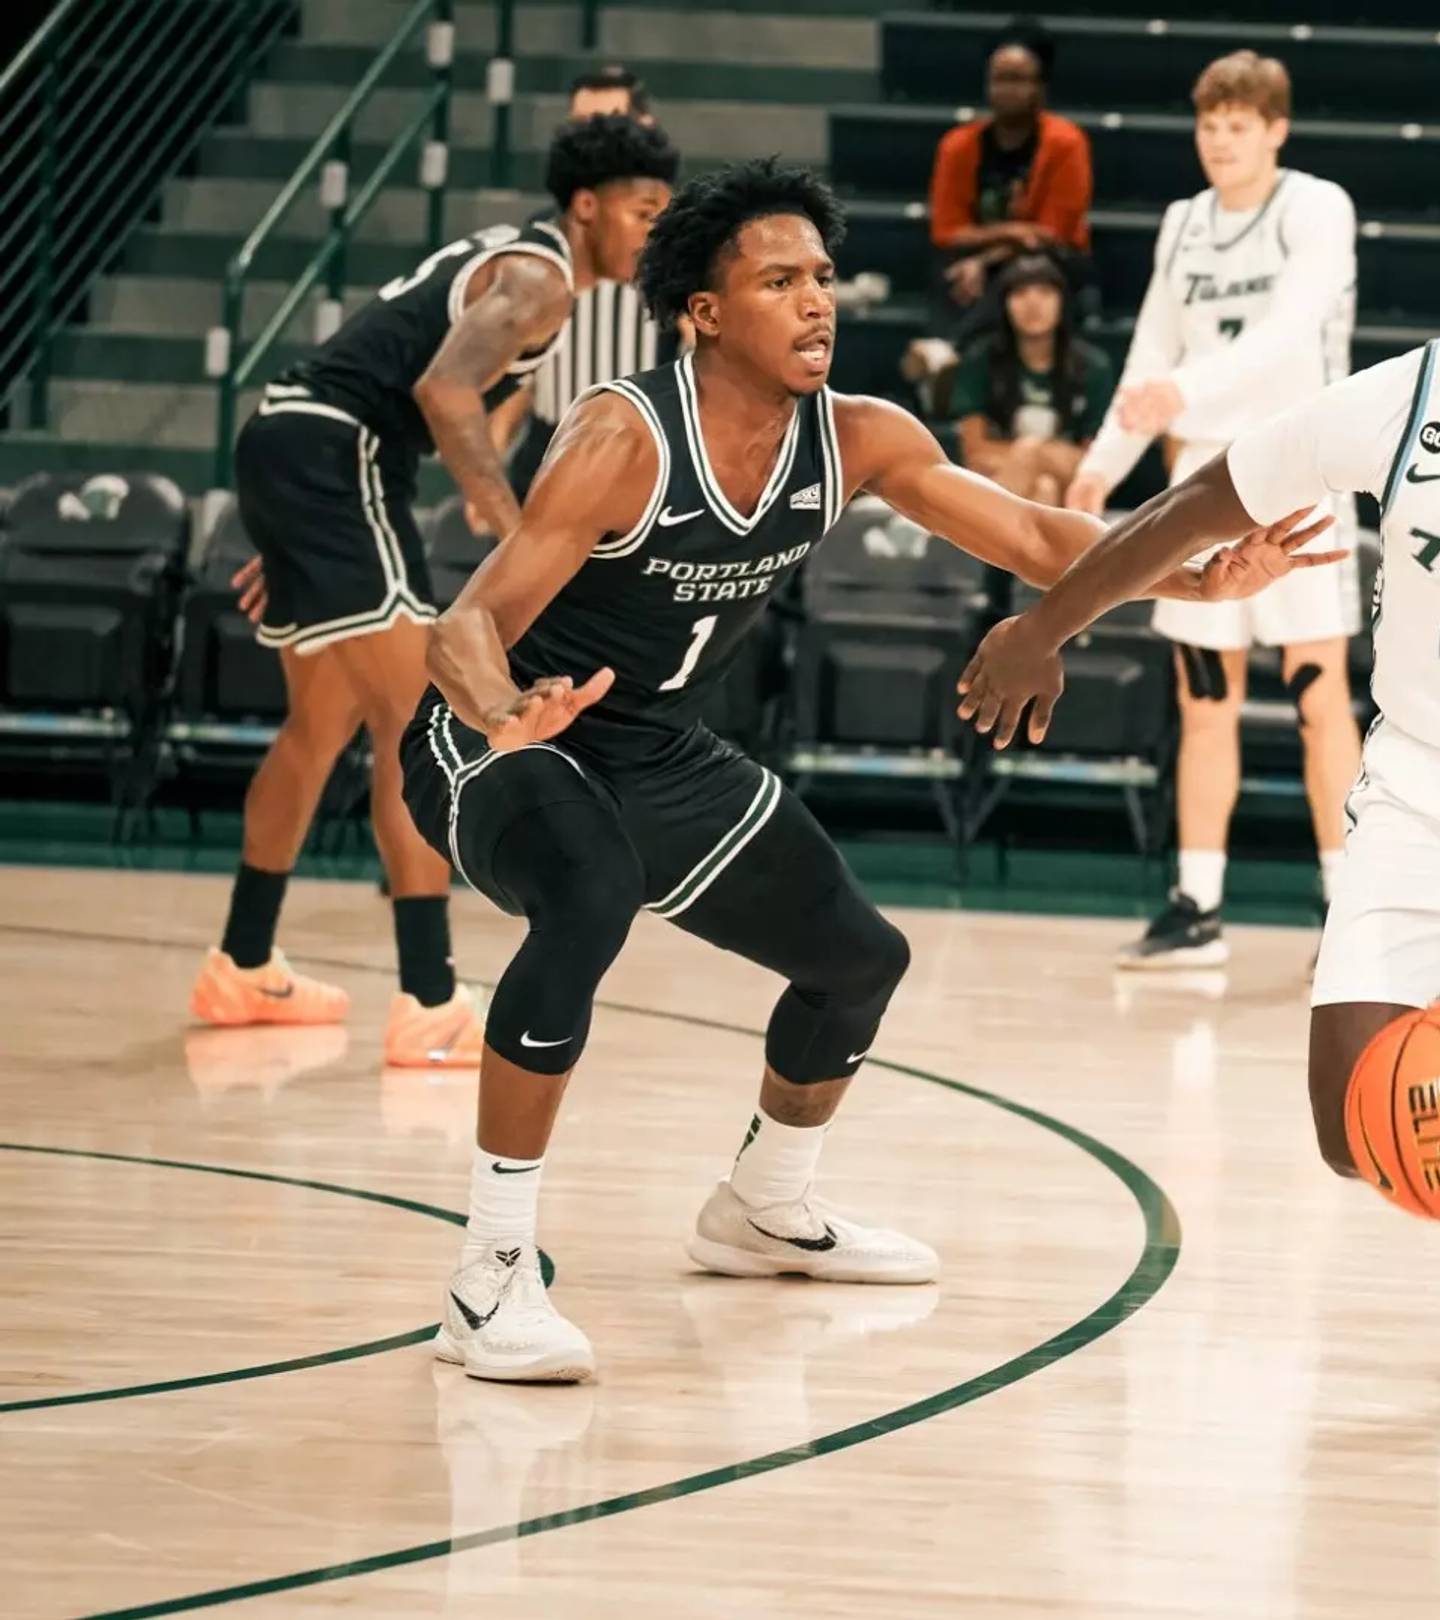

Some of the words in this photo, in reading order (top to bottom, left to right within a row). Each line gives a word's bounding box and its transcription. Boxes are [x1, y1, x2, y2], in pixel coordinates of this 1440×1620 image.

[643, 542, 811, 579] PORTLAND
[673, 576, 773, 602] STATE
[659, 615, 719, 691] 1
